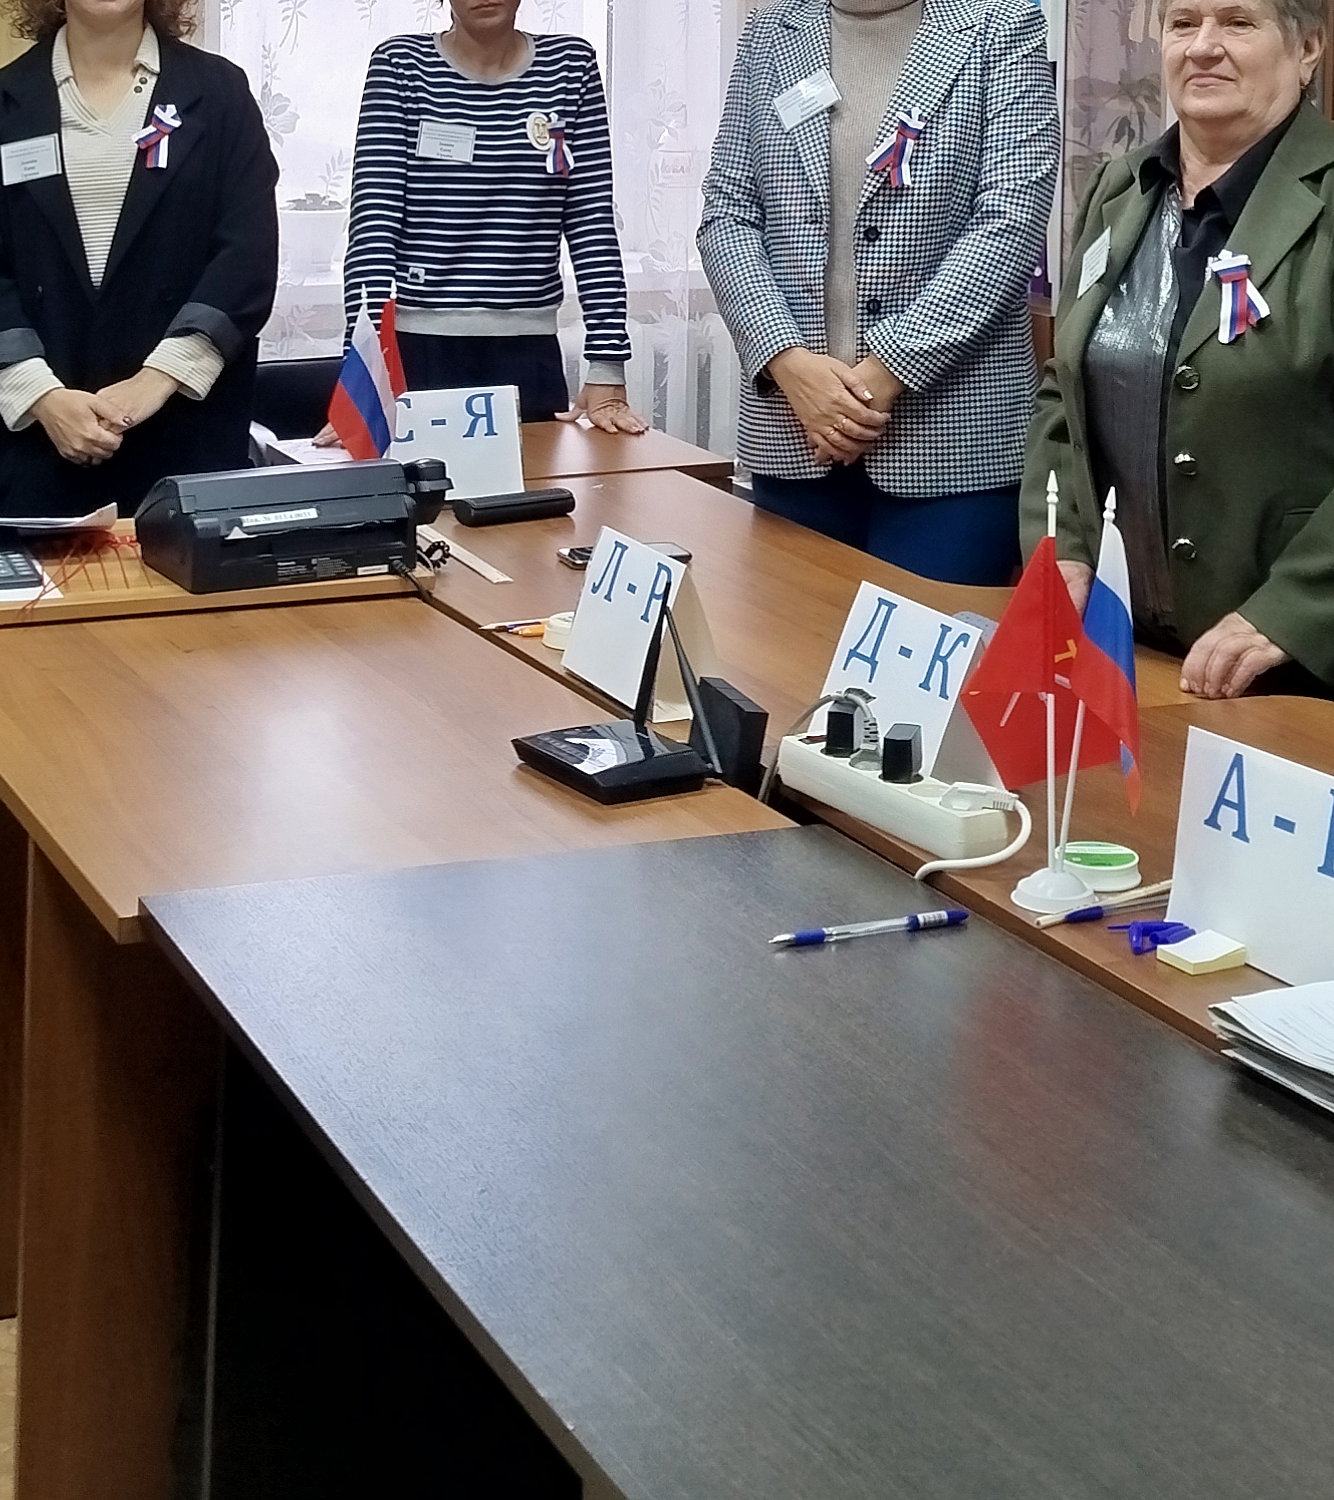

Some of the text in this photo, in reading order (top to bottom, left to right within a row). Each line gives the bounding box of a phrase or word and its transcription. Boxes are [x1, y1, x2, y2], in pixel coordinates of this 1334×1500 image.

[462, 392, 498, 438] Я
[591, 540, 629, 603] Л
[640, 561, 672, 624] Р
[843, 596, 898, 683] Д
[918, 623, 971, 700] К
[1203, 752, 1250, 844] А
